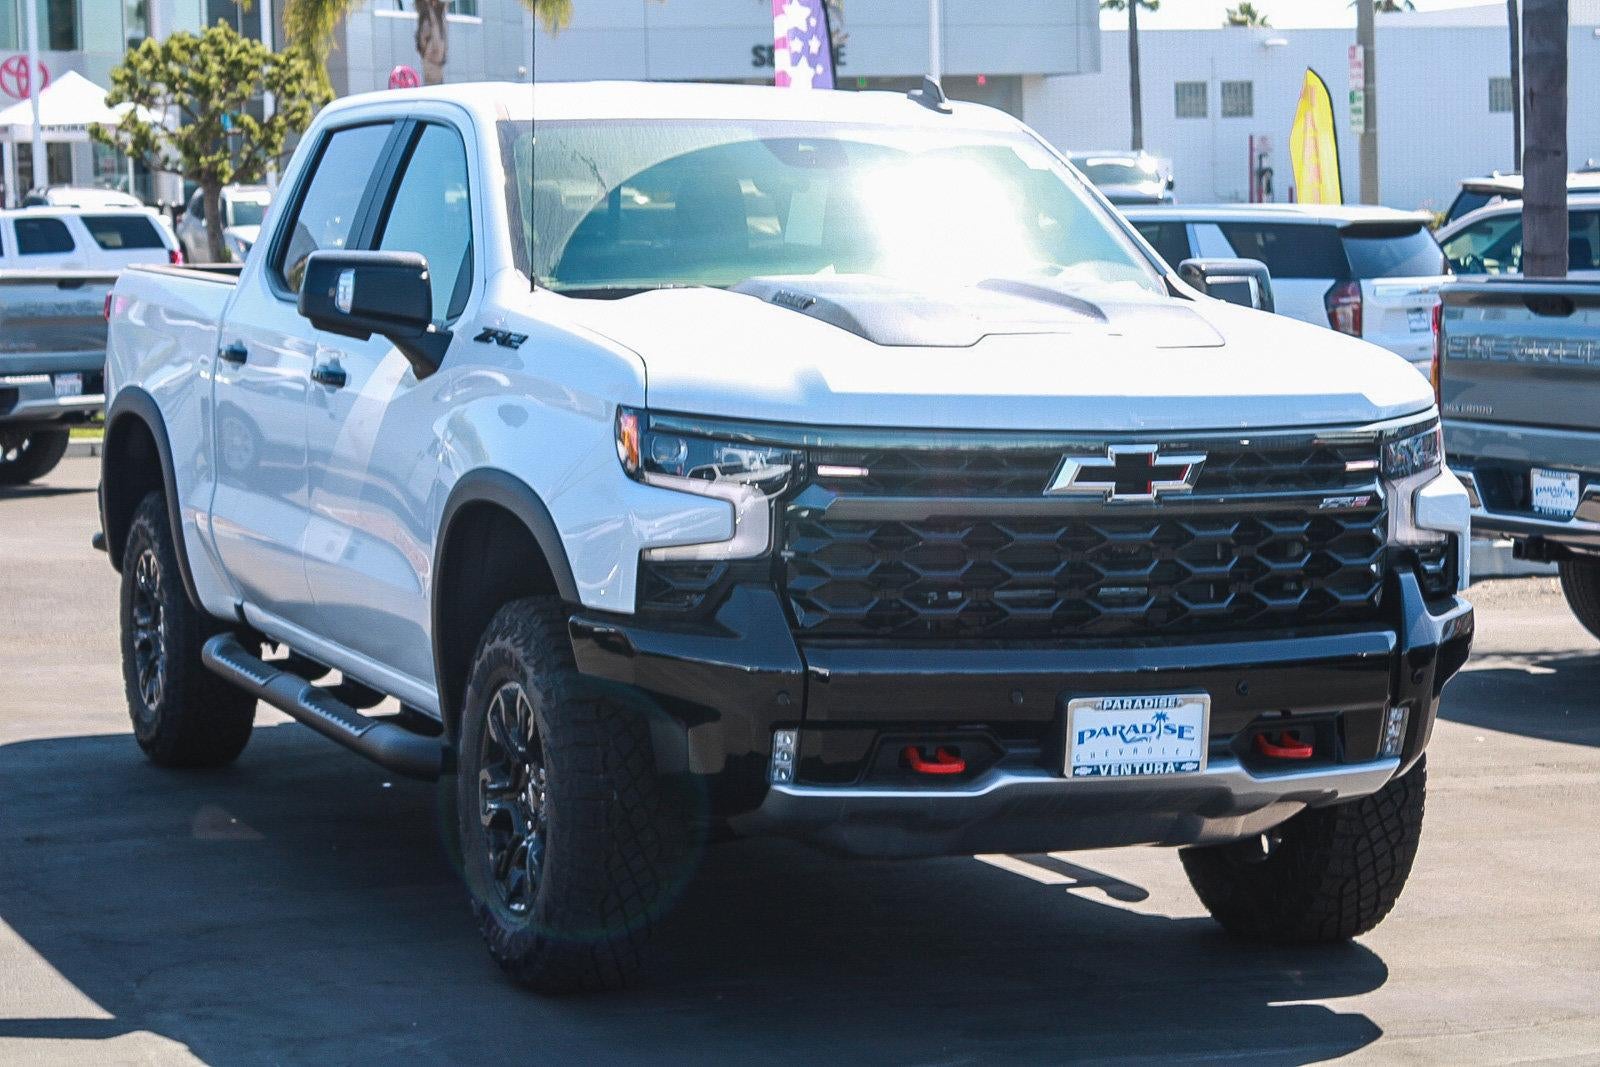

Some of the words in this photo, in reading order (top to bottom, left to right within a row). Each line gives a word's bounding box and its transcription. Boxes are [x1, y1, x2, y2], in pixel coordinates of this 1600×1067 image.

[40, 124, 86, 132] ENTURA
[473, 326, 529, 350] ZR2
[1103, 697, 1178, 711] PARADISE
[1077, 711, 1195, 745] PARADISE
[1075, 747, 1194, 762] CHEVROLET
[1100, 762, 1176, 776] VENTURA
